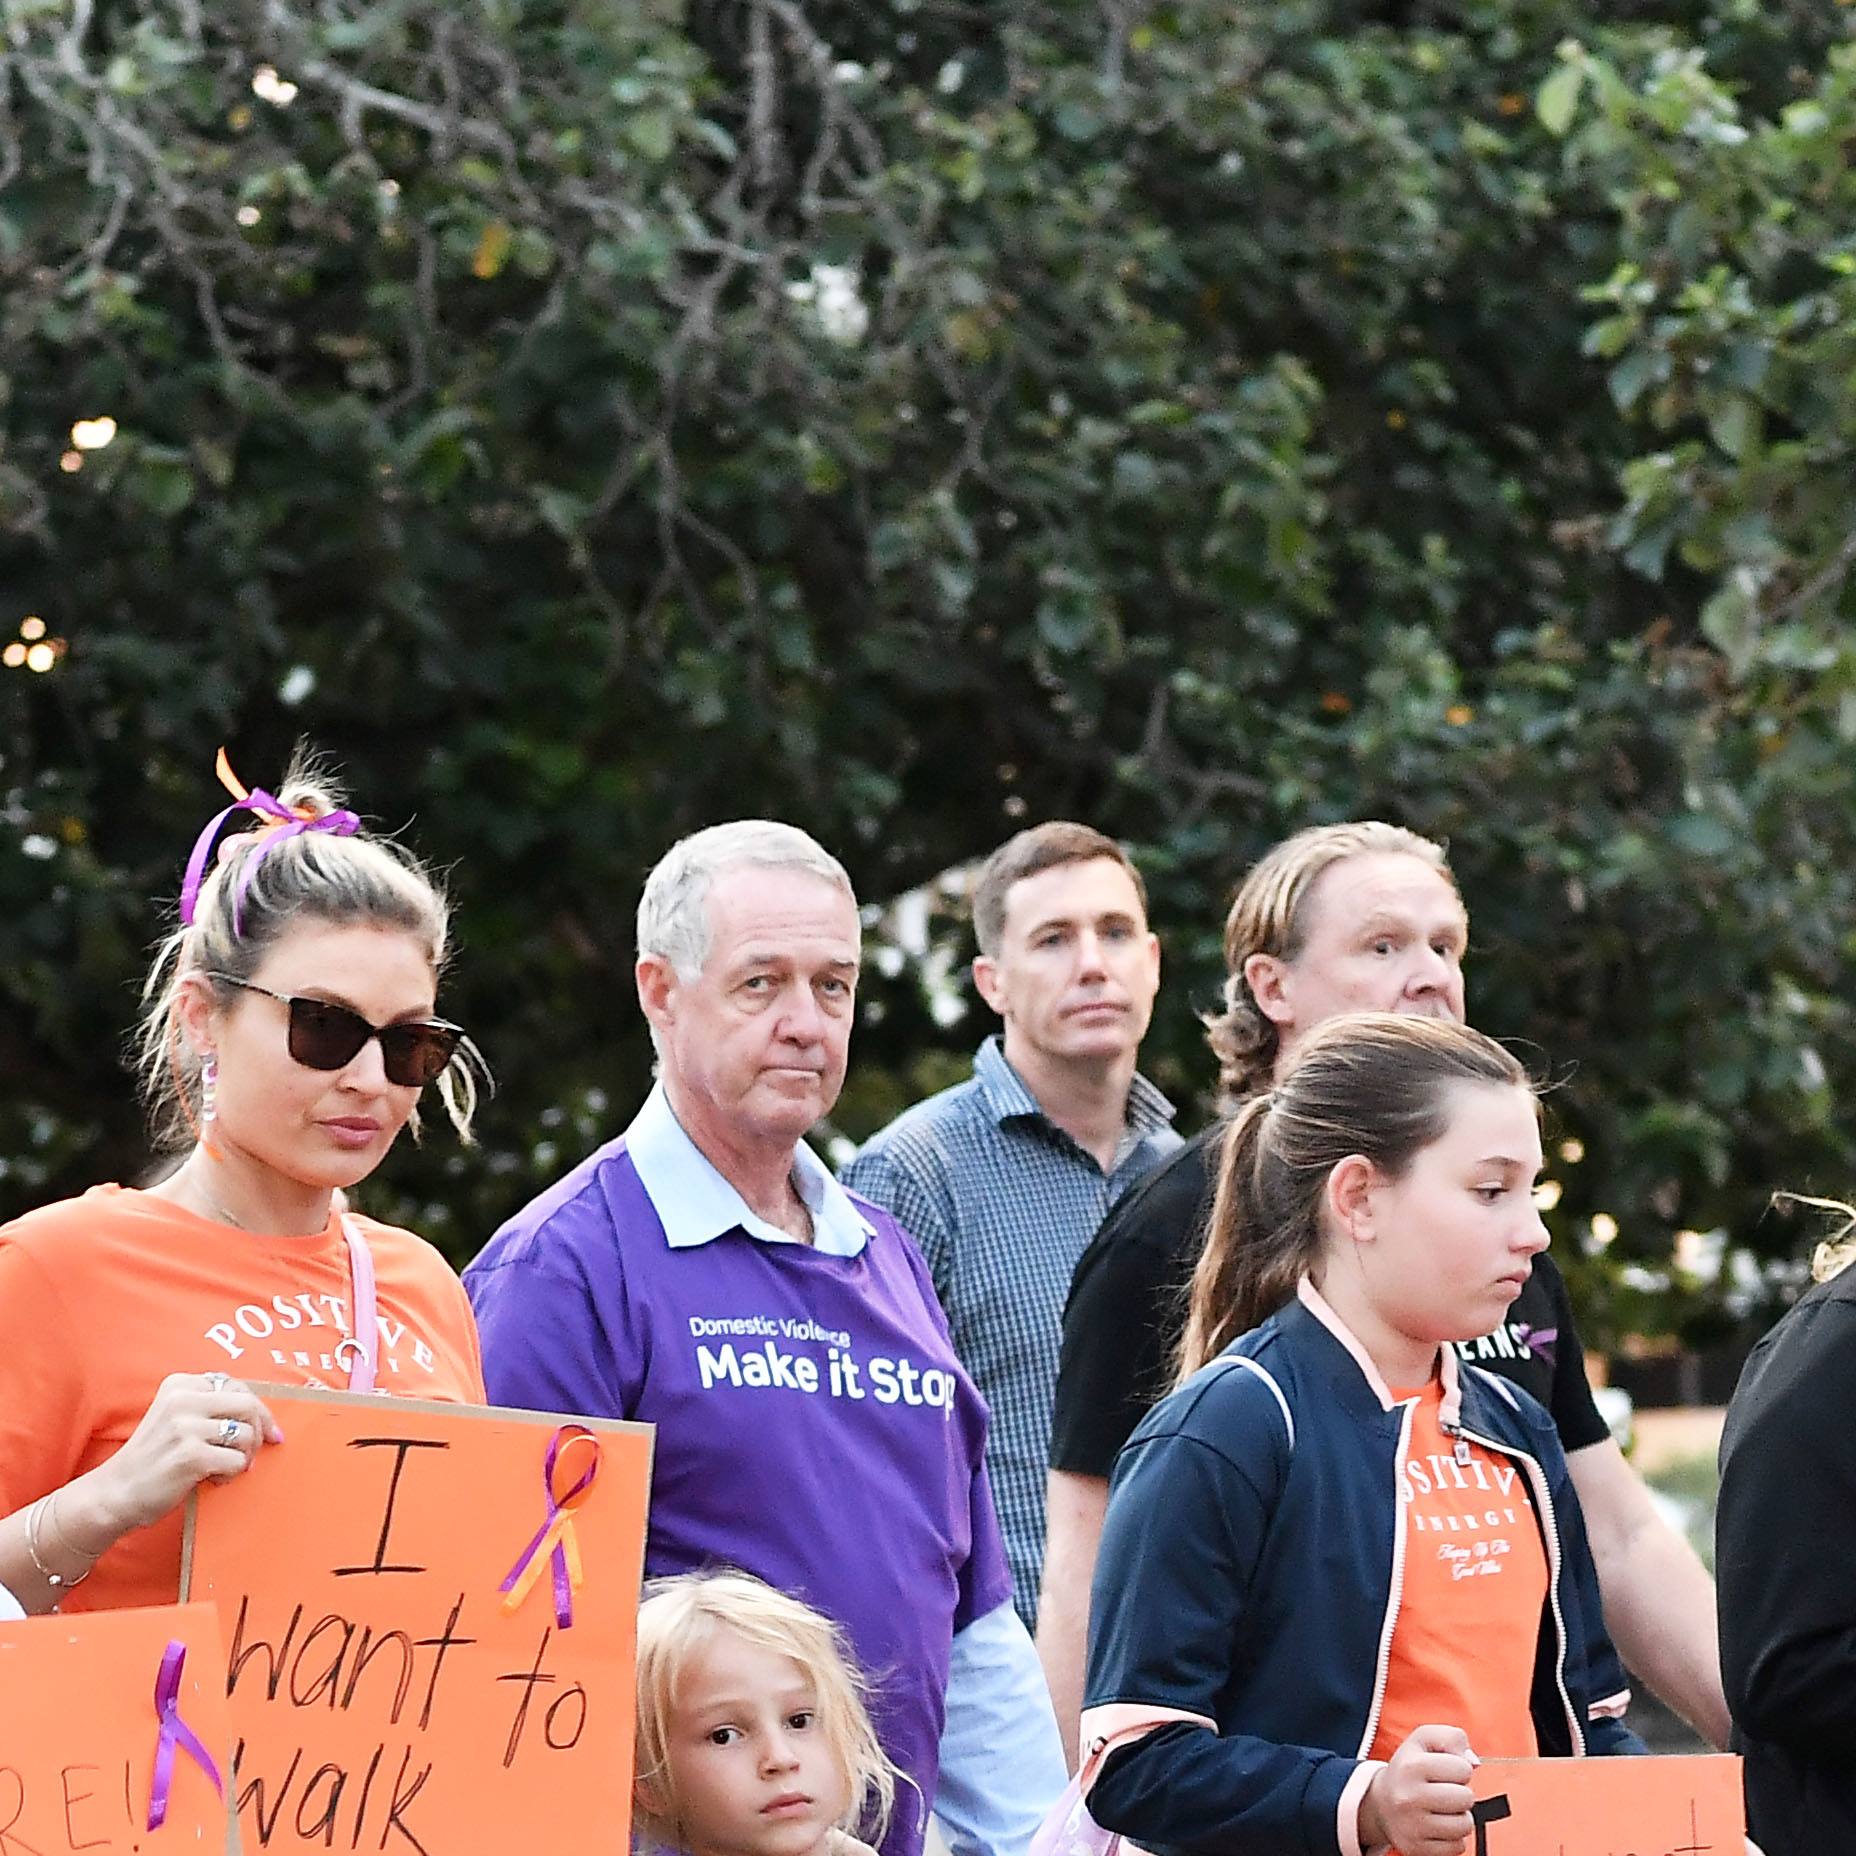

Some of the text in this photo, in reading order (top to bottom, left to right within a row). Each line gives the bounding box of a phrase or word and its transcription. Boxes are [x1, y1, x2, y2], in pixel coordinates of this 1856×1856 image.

[204, 1292, 435, 1374] POSITVE
[688, 1315, 779, 1338] Domestic
[696, 1340, 819, 1394] Make
[828, 1347, 866, 1400] it
[332, 1437, 450, 1578] I
[1402, 1454, 1531, 1504] SITIV
[496, 1624, 588, 1768] to
